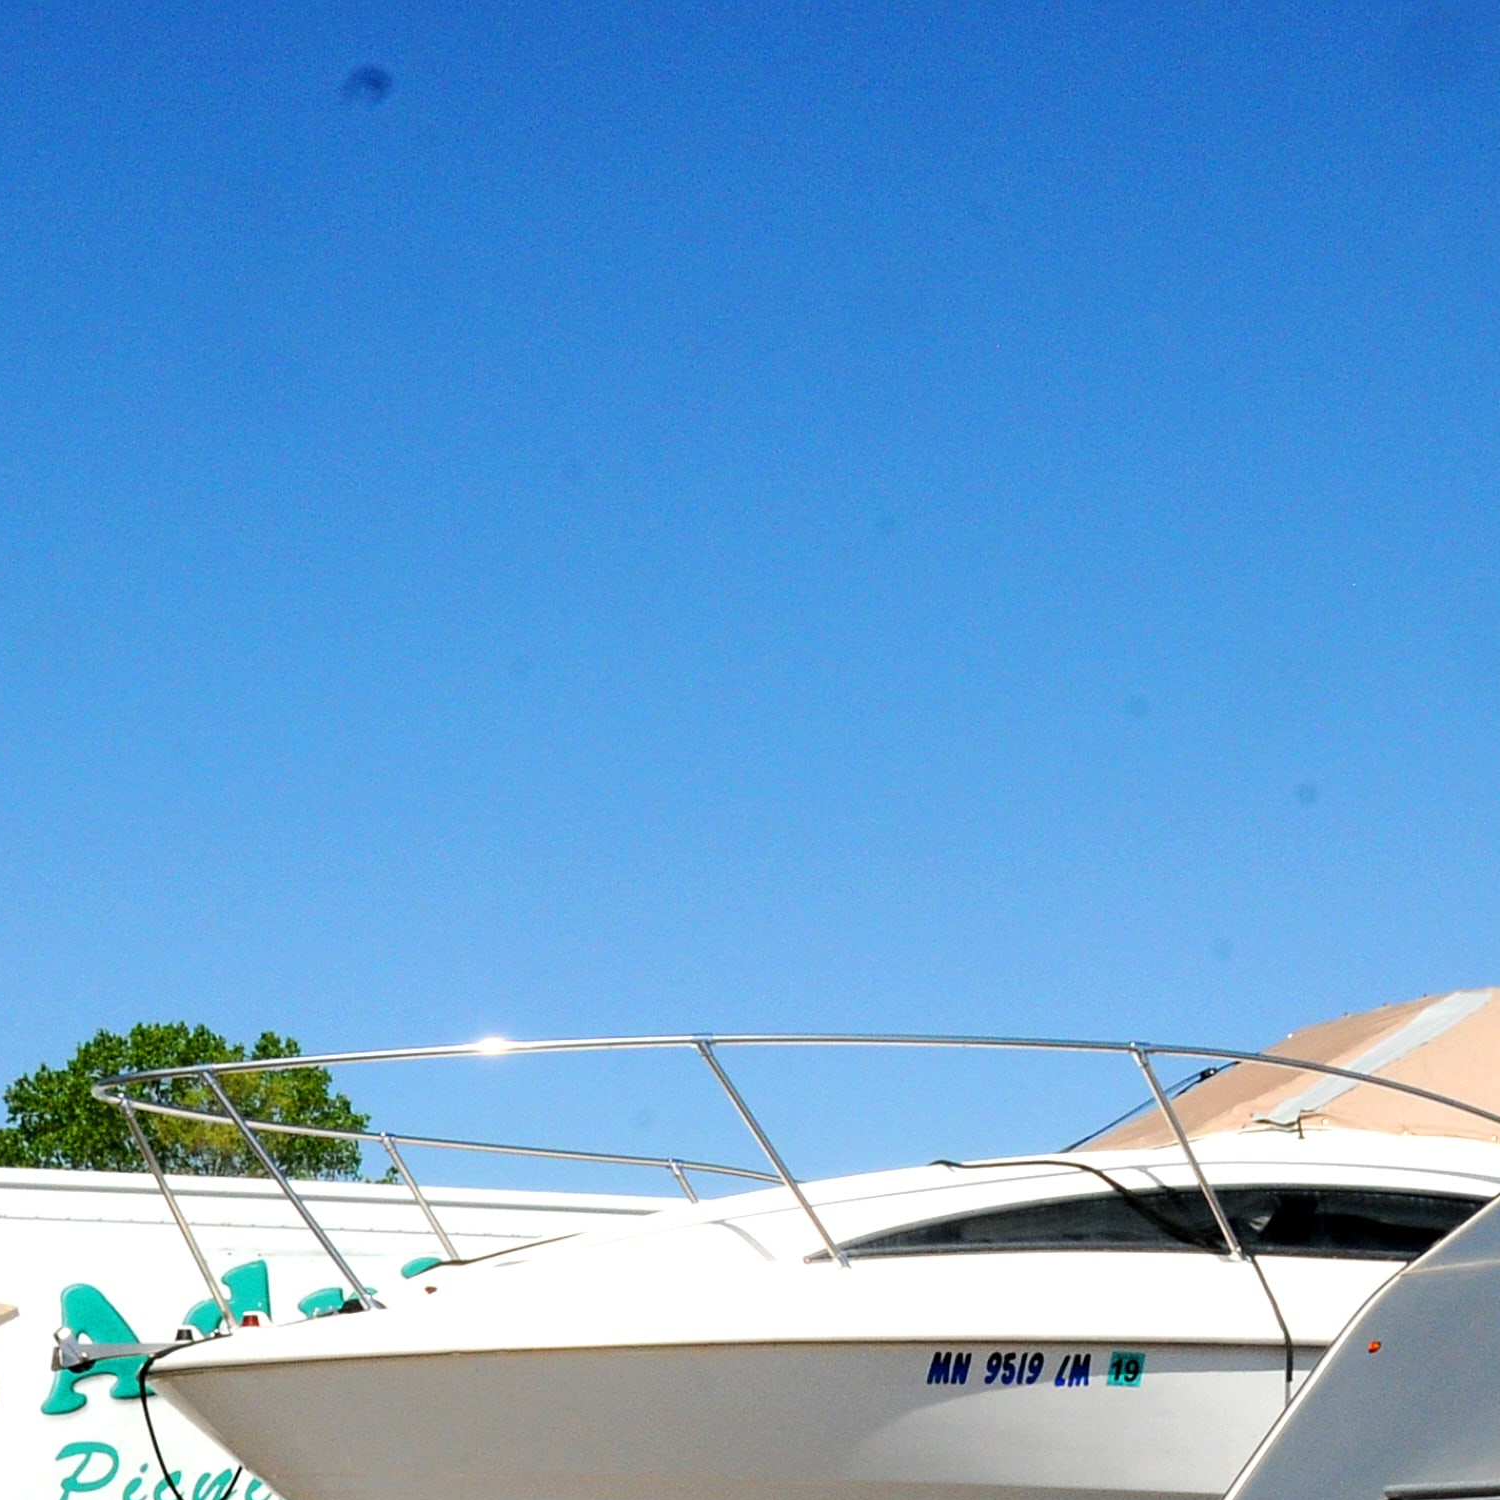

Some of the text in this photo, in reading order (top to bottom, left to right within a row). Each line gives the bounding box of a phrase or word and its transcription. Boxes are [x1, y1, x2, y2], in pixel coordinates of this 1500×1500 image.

[926, 1351, 1092, 1388] MN 9519 LM
[1111, 1358, 1141, 1383] 19
